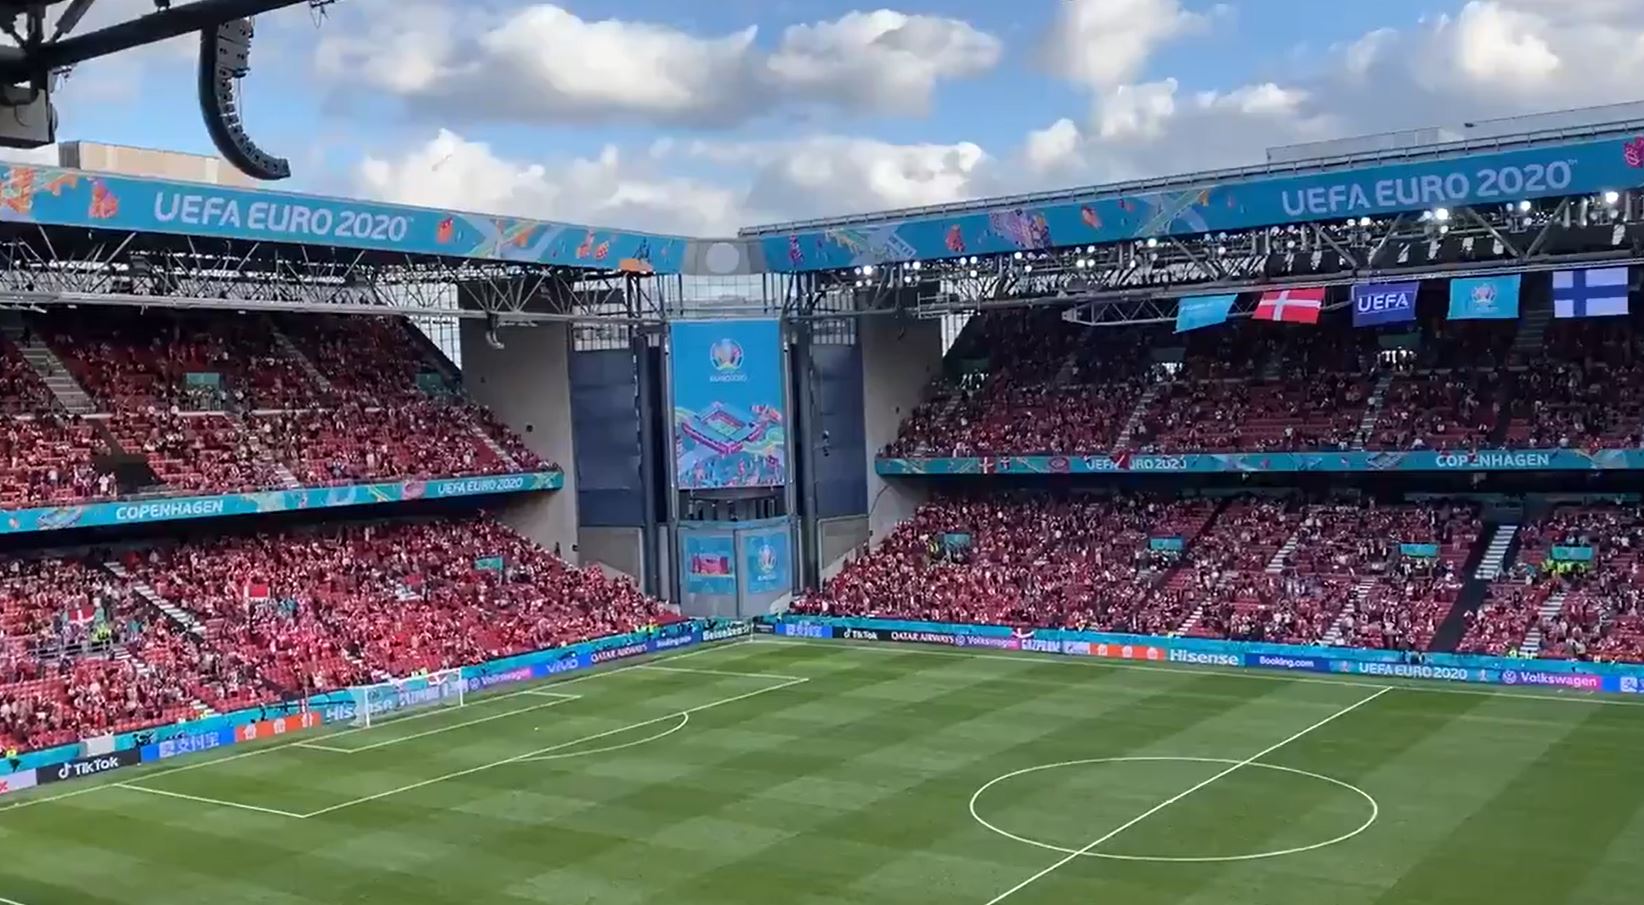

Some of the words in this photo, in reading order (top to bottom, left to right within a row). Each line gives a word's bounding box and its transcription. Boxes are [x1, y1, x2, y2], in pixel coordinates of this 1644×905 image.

[1281, 182, 1371, 217] UEFA
[1375, 173, 1470, 208] EURO
[154, 191, 241, 229] UEFA
[247, 201, 333, 236] EURO
[1357, 292, 1409, 313] UEFA
[437, 481, 466, 495] UEFA
[115, 499, 224, 520] COPENHAGEN
[1170, 649, 1239, 666] Hisense
[1259, 655, 1314, 669] Booking.com
[1359, 662, 1395, 675] UEFA
[1394, 664, 1434, 678] EURO
[1432, 666, 1468, 680] 2020
[1520, 672, 1597, 688] Volkswagen
[73, 756, 119, 776] TikTok
